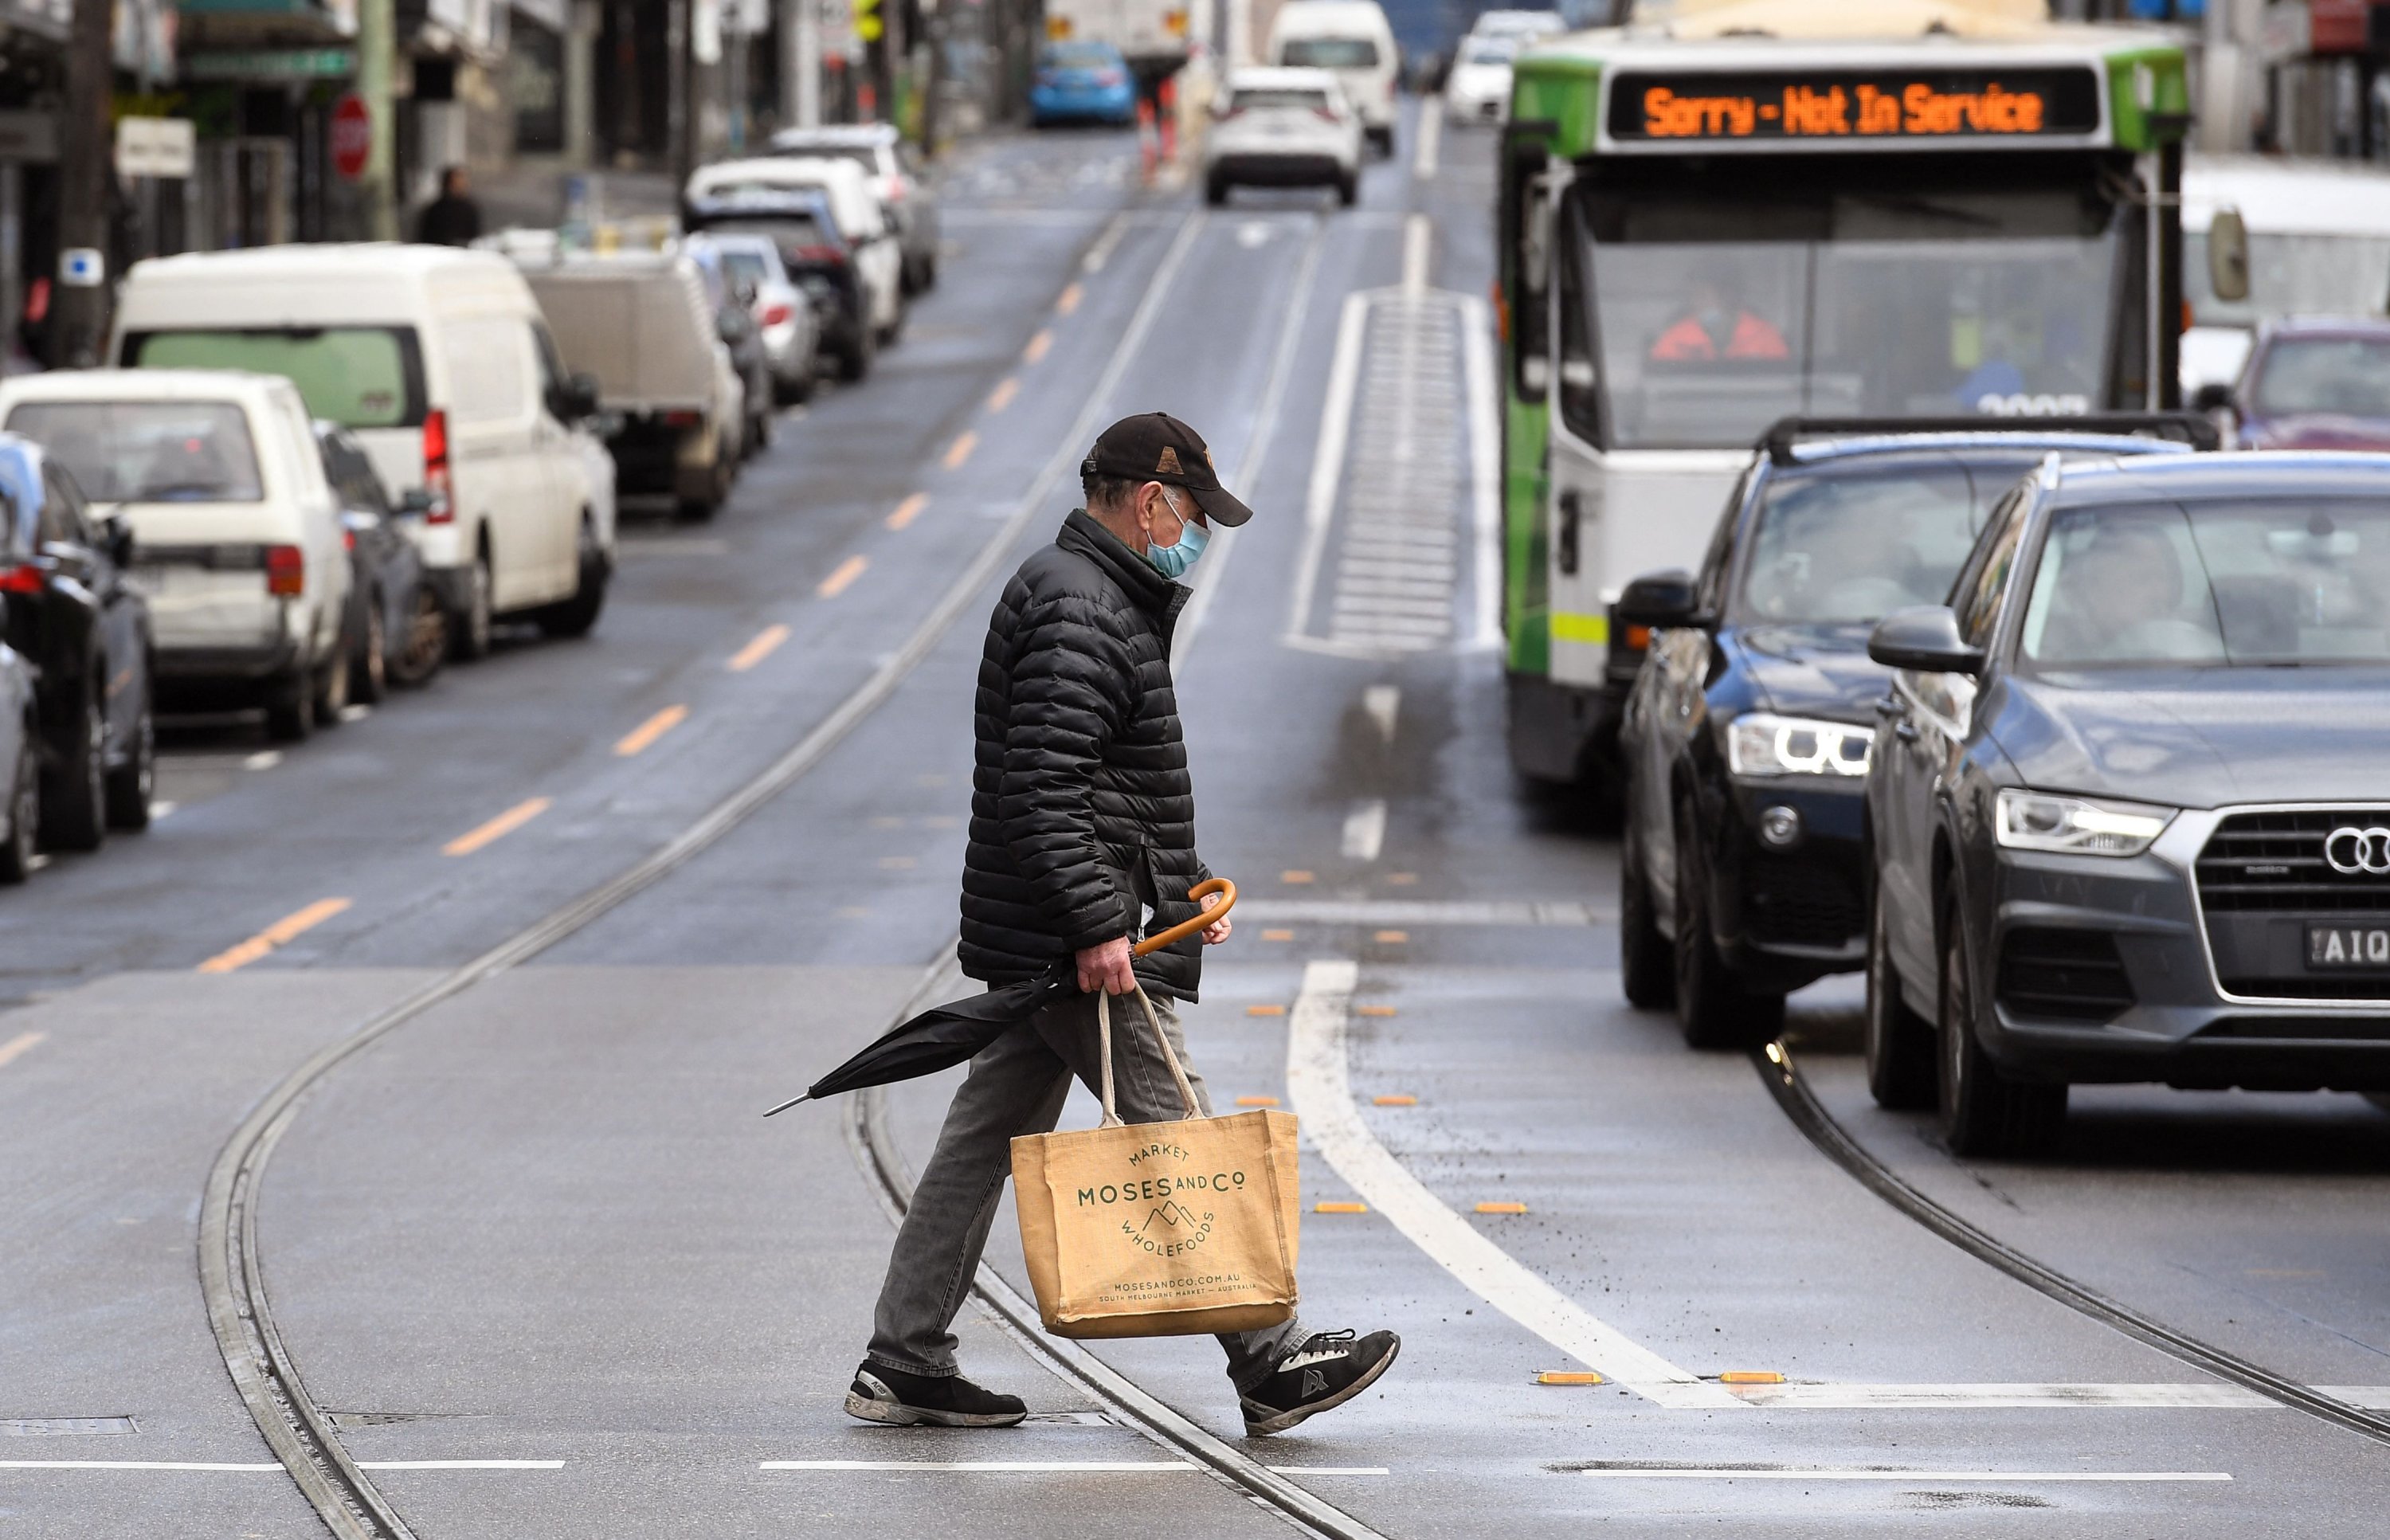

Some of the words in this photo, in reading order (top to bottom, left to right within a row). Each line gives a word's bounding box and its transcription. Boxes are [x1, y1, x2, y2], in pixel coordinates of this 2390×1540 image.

[1644, 87, 1755, 136] Sorry
[1783, 84, 1849, 135] Not
[1855, 84, 1900, 135] In
[1903, 82, 2044, 134] Service
[1129, 1144, 1189, 1167] MARKET
[1078, 1178, 1172, 1206] MOSES
[1121, 1211, 1214, 1257] WHOLEFOODS
[1115, 1274, 1240, 1291] MOSESANDCO.COM.AU
[1127, 1291, 1173, 1301] MELBOURNE
[1175, 1287, 1205, 1297] MARKET
[1217, 1283, 1257, 1292] AUSTRALIA
